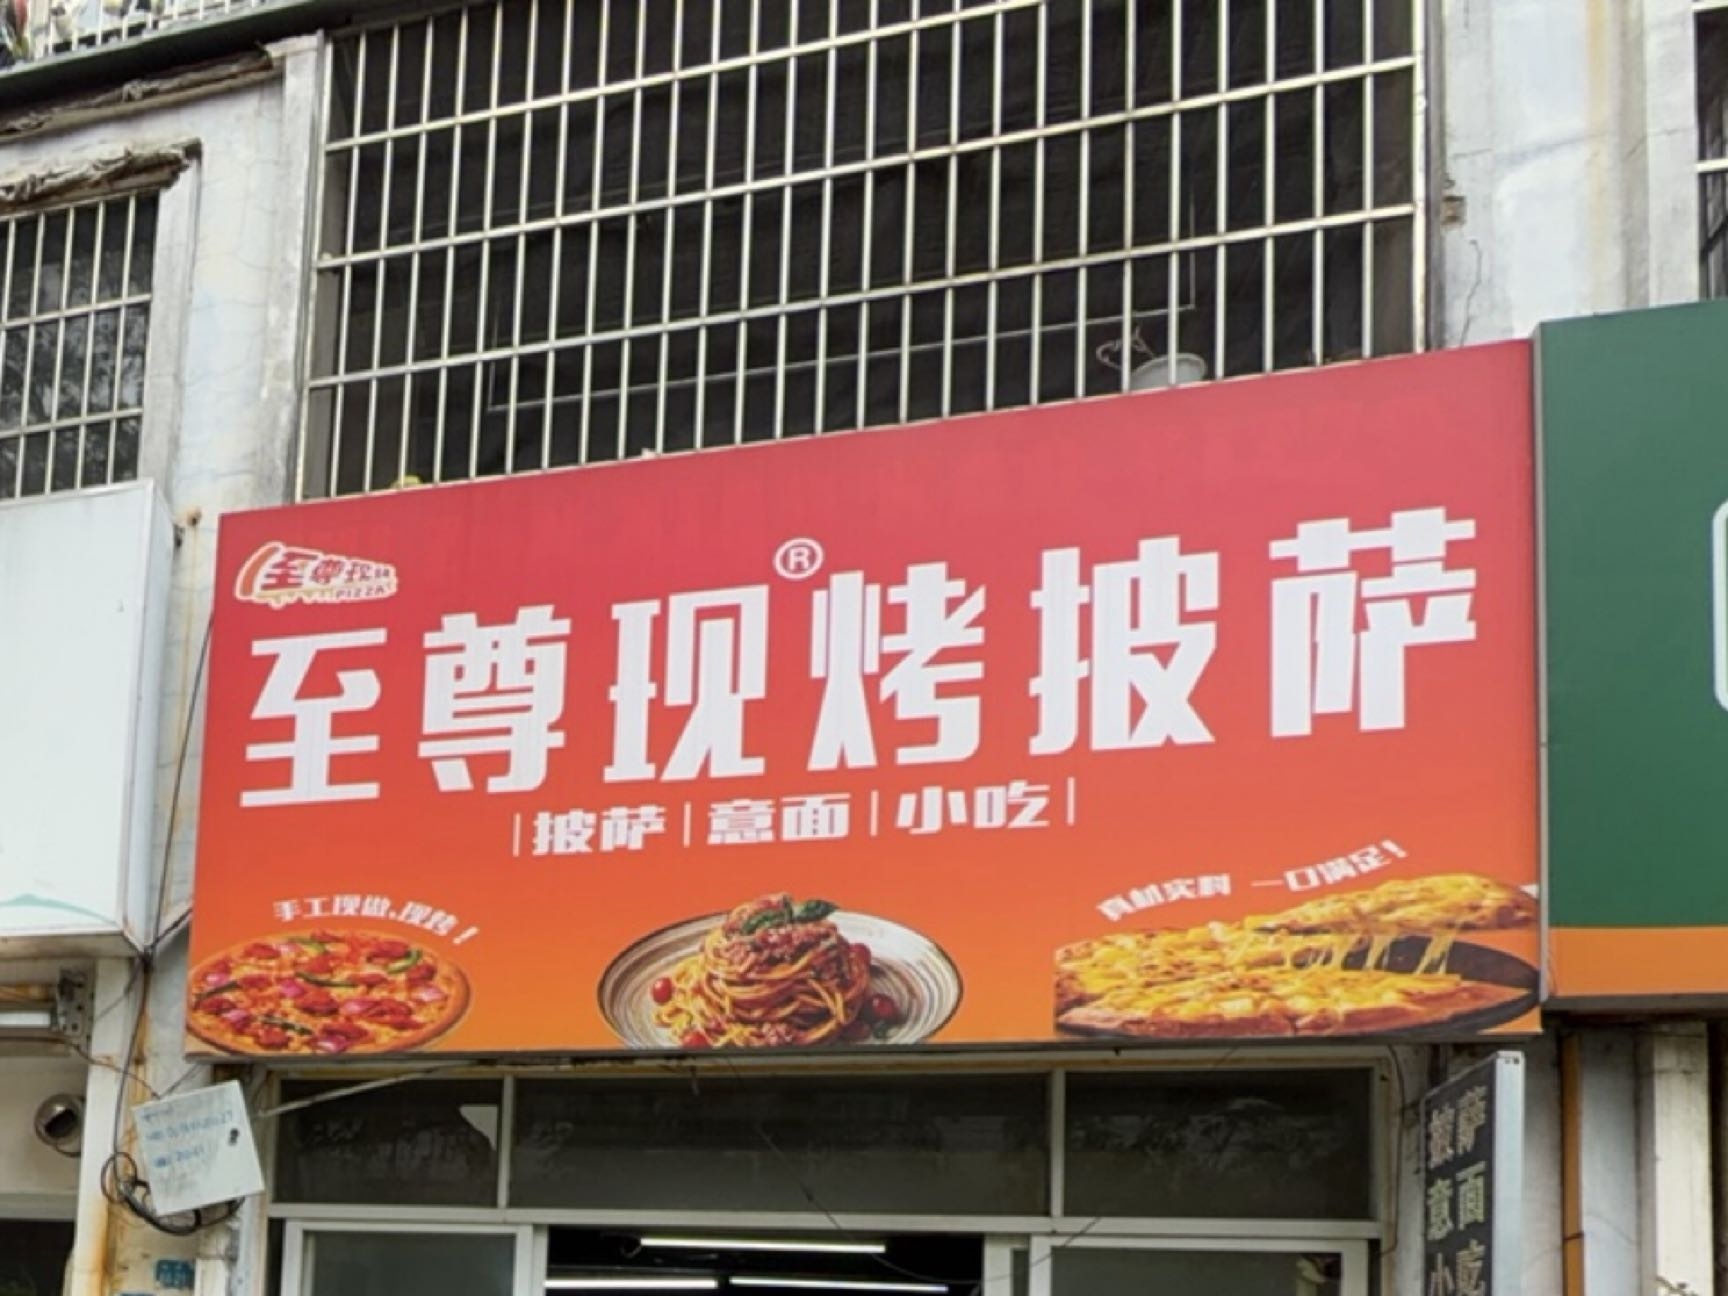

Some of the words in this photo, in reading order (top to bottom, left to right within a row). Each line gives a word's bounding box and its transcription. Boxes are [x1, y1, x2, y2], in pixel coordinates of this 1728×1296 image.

[240, 507, 1478, 808] 至尊现烤披萨
[532, 804, 666, 856] 披萨
[707, 793, 851, 845] 意面
[896, 779, 1050, 836] 小吃
[1427, 1160, 1485, 1241] 意面
